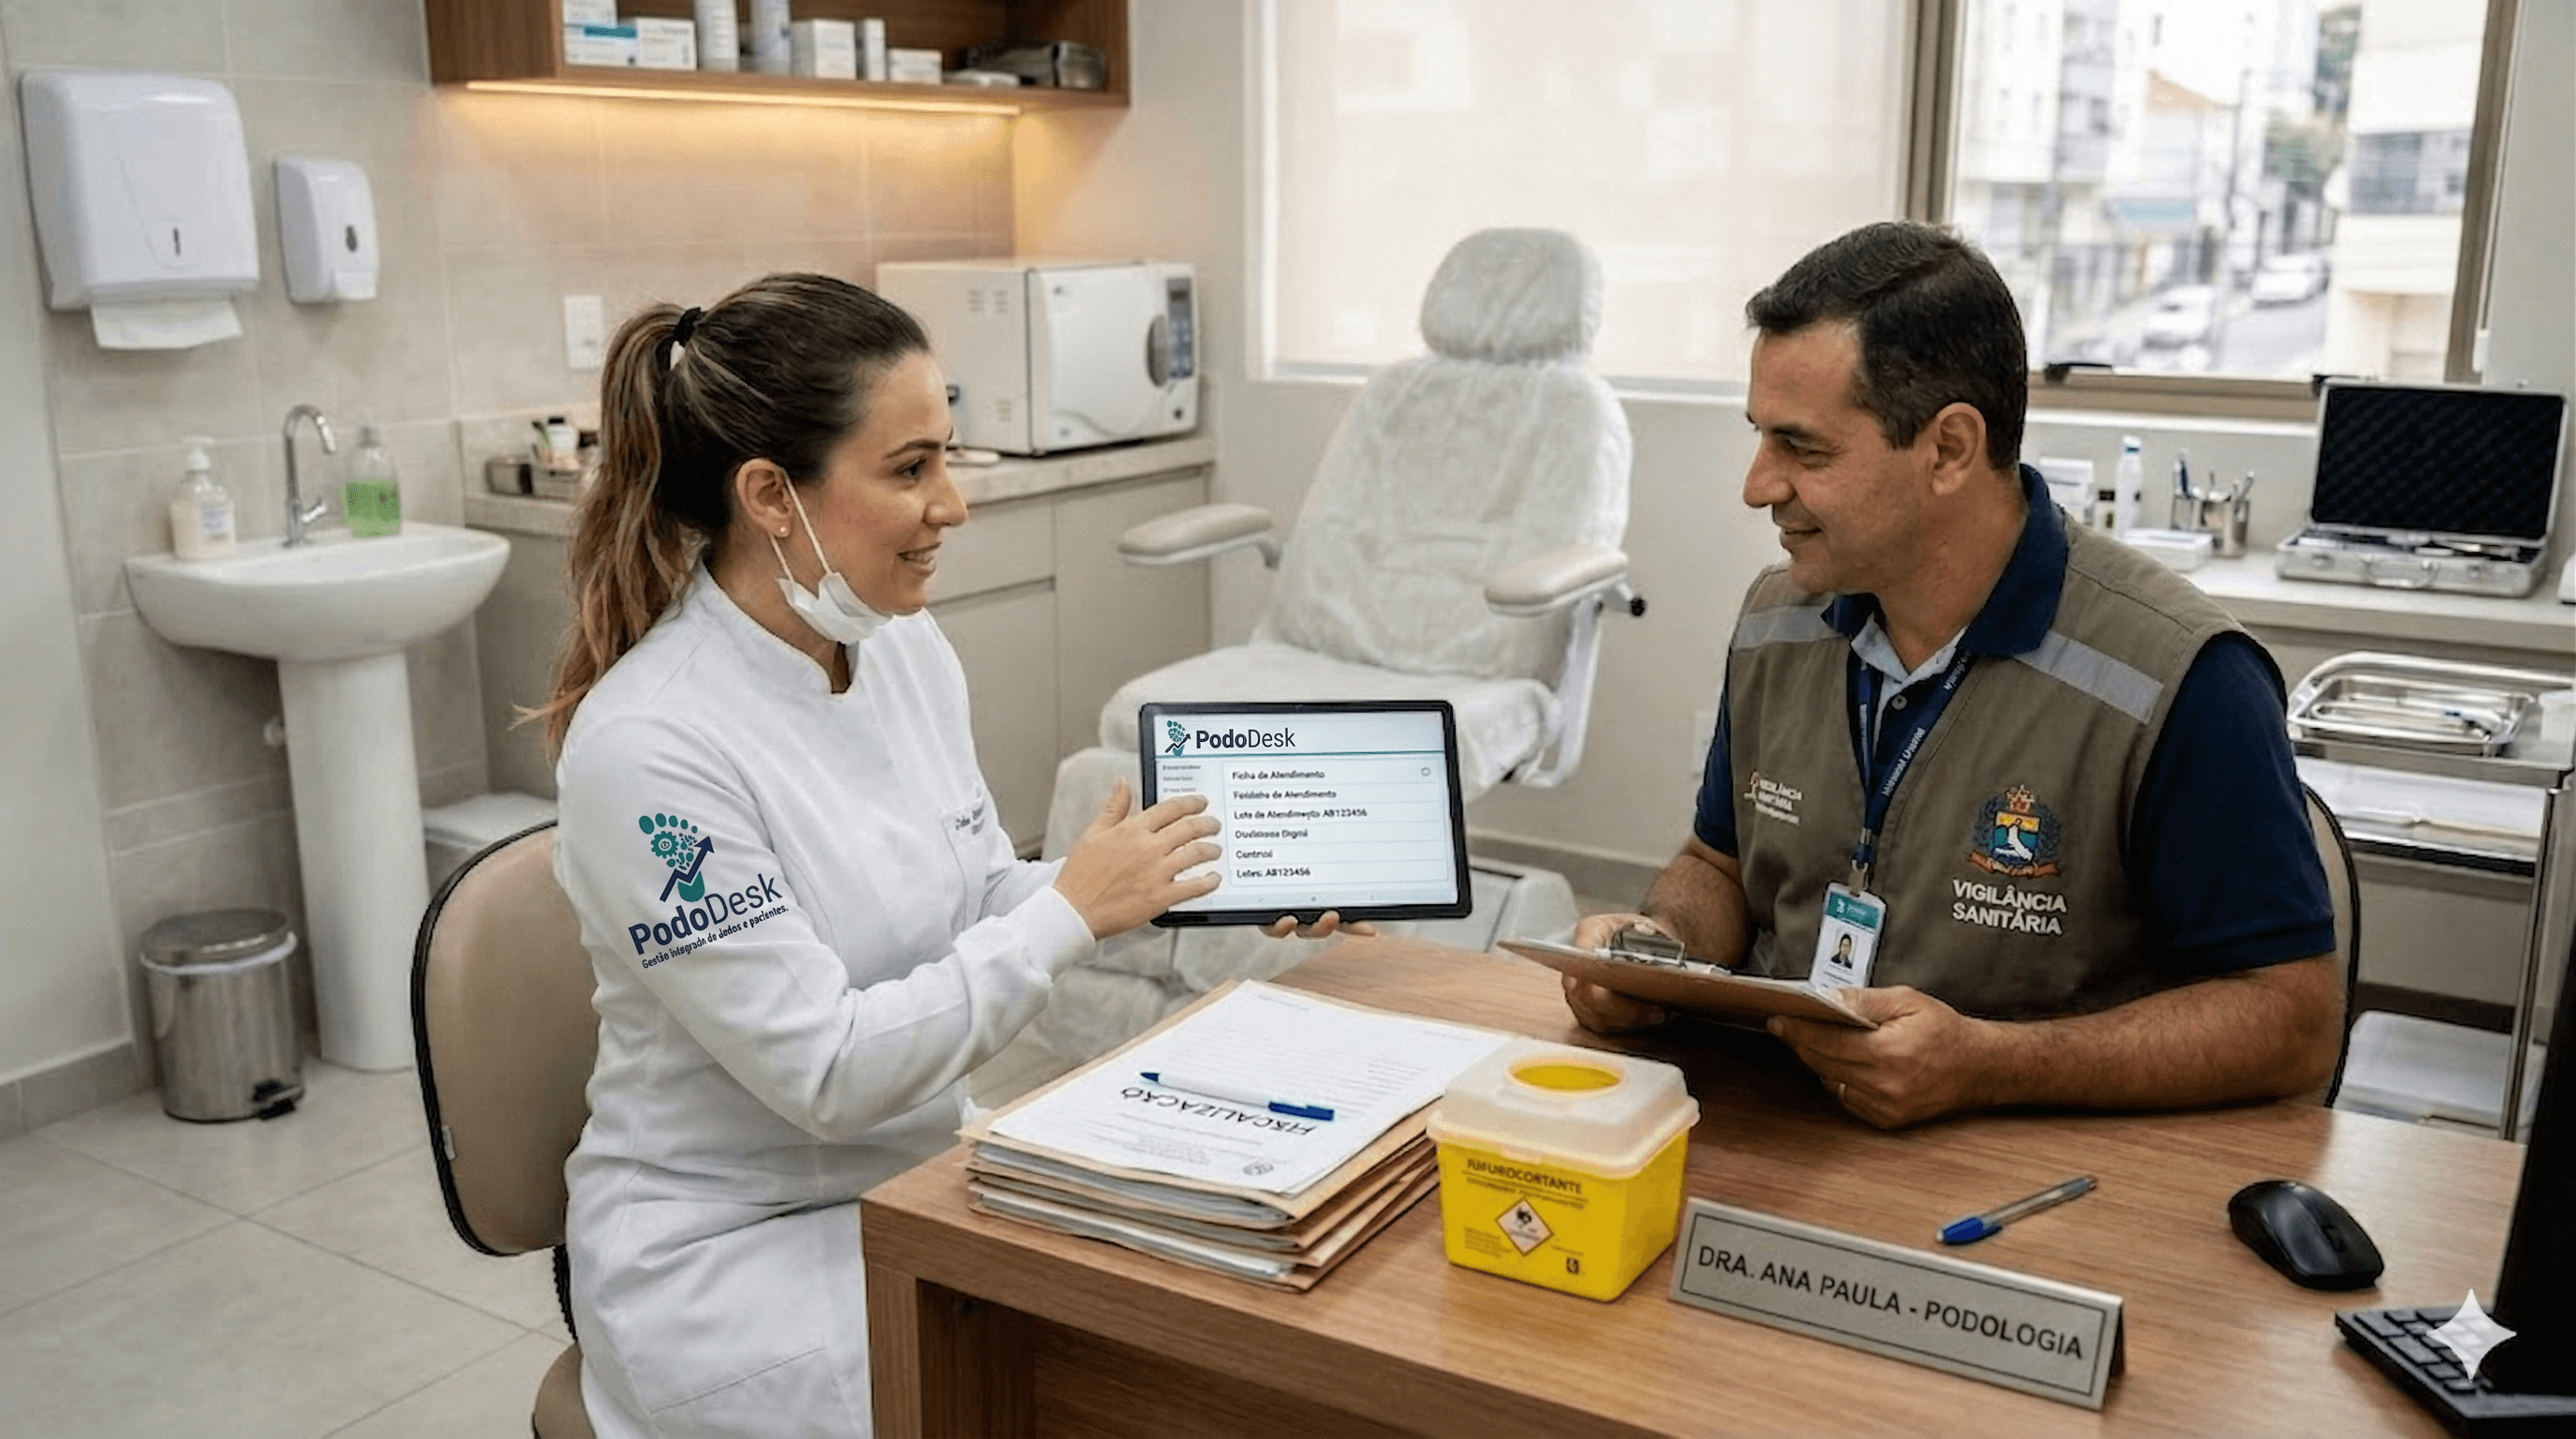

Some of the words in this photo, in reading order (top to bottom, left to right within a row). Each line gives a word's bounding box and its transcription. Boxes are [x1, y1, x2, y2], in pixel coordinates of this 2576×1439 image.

[1196, 727, 1295, 749] PodoDesk
[1257, 770, 1268, 779] de
[1952, 879, 2067, 913] VIGILÂNCIA
[628, 873, 783, 956] PodoDesk
[1952, 902, 2063, 935] SANITÁRIA
[707, 932, 717, 943] de
[1697, 1245, 1754, 1280] DRA.
[1760, 1260, 1812, 1294] ANA
[1818, 1275, 1902, 1315] PAULA
[1924, 1301, 2083, 1359] PODOLOGIA
